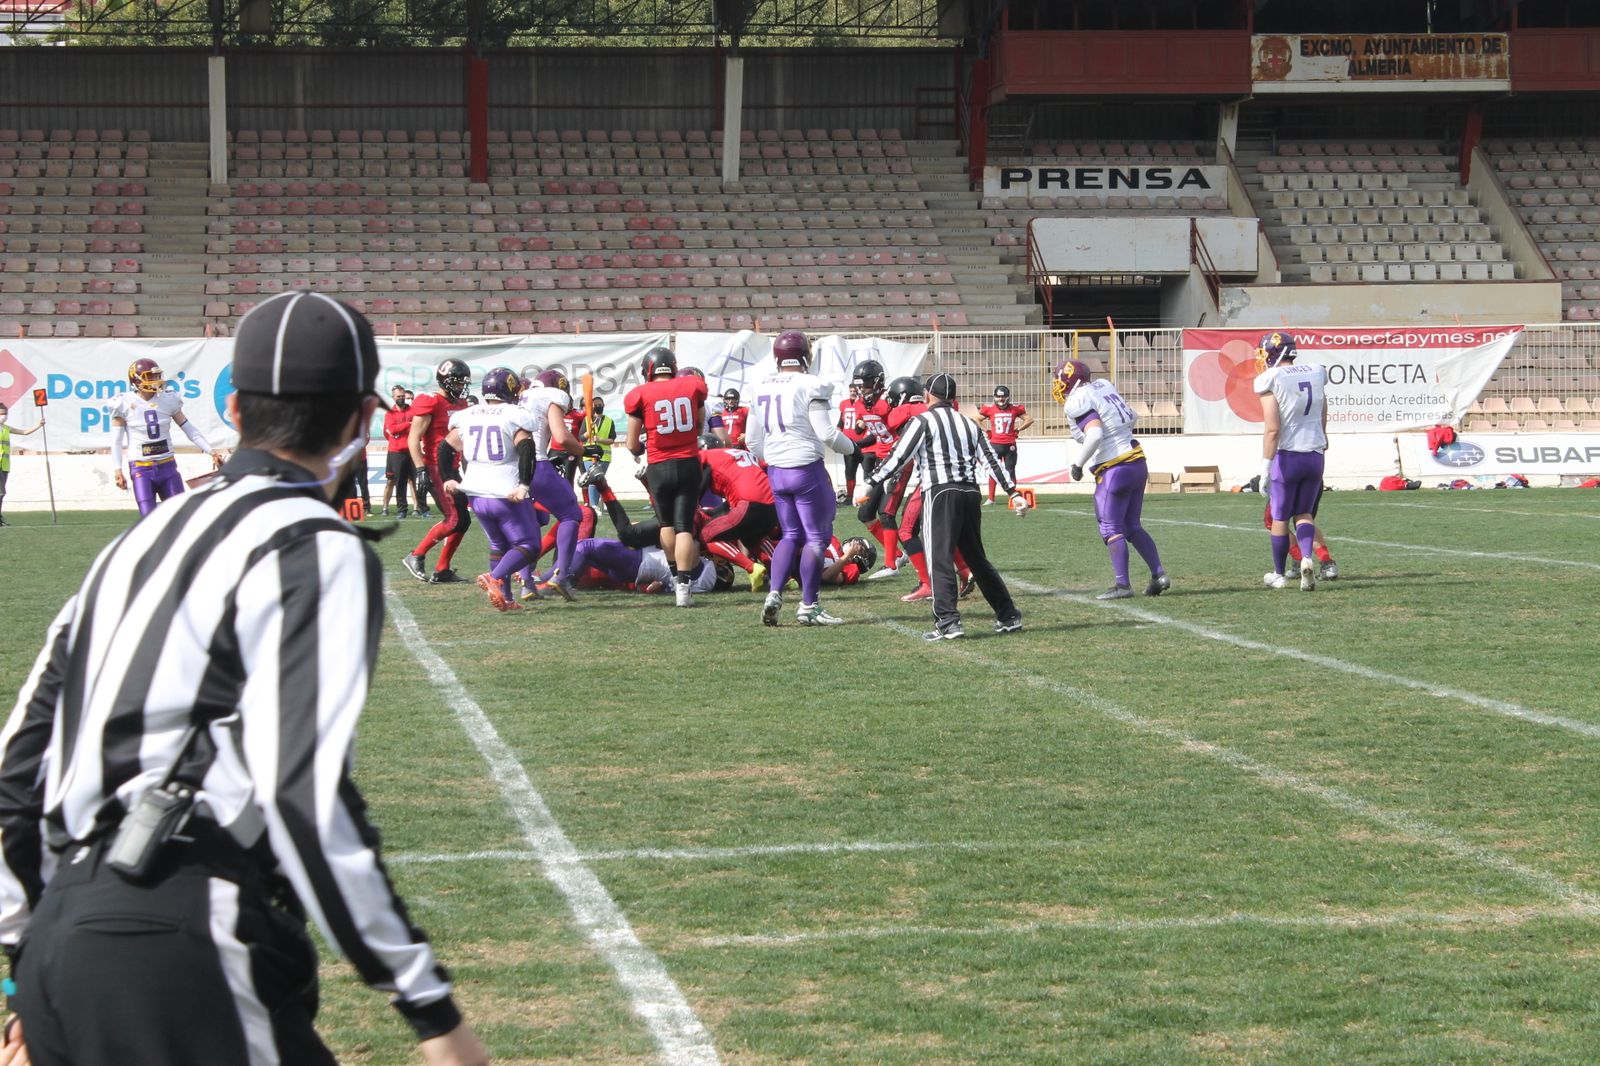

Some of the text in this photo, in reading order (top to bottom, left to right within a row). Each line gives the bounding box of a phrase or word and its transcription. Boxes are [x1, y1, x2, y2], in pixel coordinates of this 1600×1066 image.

[1300, 37, 1502, 56] EXCMO. AYUNTAMIENTO DE
[1348, 58, 1411, 76] ALMERIA
[1001, 168, 1211, 190] PRENSA
[1284, 364, 1313, 374] LINCES
[1321, 364, 1427, 385] ONECTA
[47, 371, 201, 400] Domo's
[35, 389, 47, 406] 2
[1298, 381, 1313, 416] 7
[144, 410, 160, 439] 8
[654, 397, 694, 435] 30
[757, 394, 787, 434] 71
[844, 411, 856, 430] 61
[1326, 410, 1455, 423] odafone de Empresas
[995, 417, 1012, 434] 87
[469, 425, 504, 461] 70
